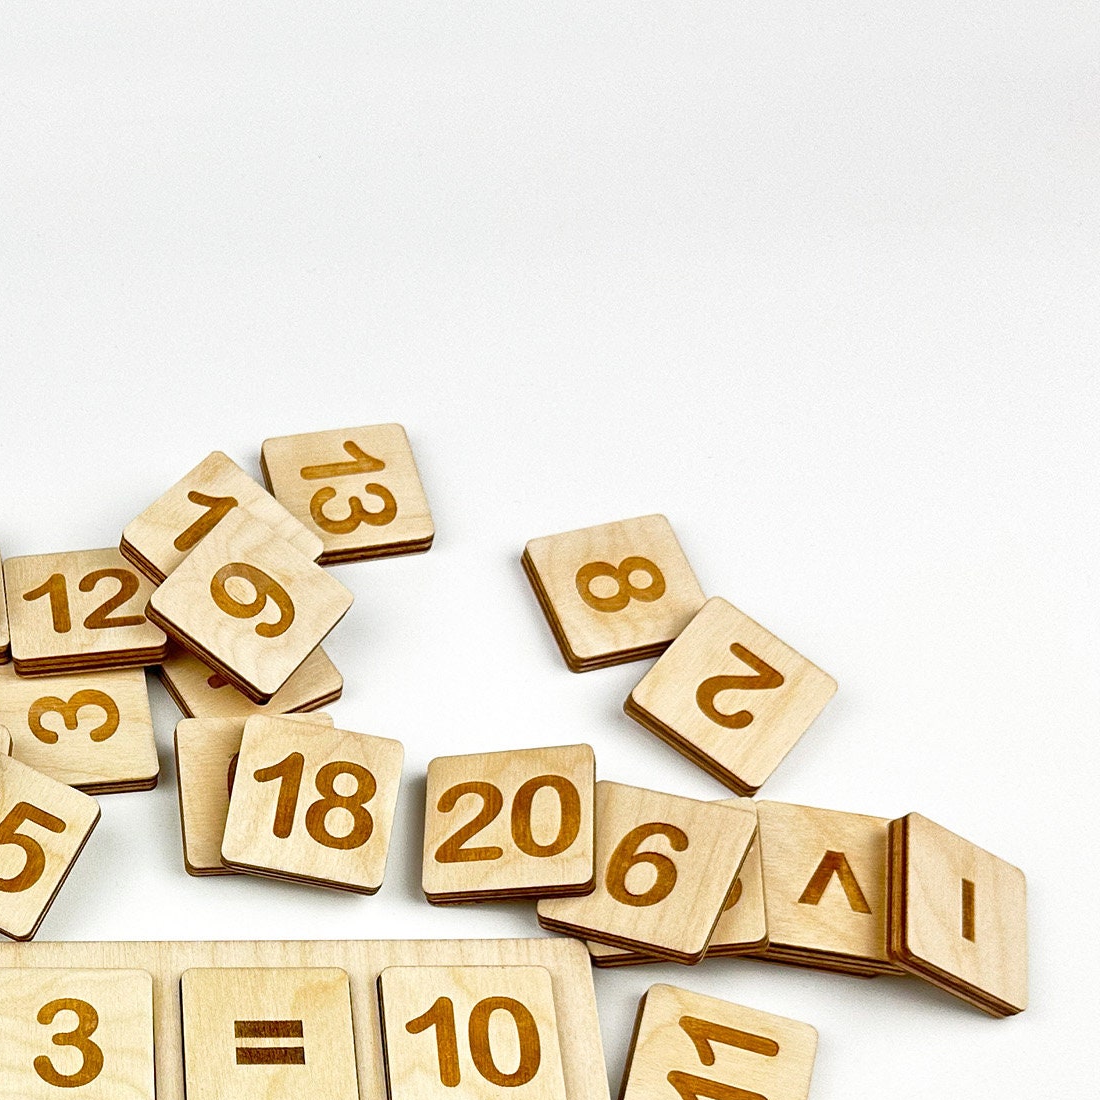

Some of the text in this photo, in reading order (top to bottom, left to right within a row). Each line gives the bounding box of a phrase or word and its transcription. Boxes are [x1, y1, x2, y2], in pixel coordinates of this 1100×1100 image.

[300, 441, 397, 534] 13
[23, 568, 147, 633] 12
[576, 556, 666, 612] 8
[28, 688, 120, 745] 3
[696, 643, 784, 729] 2
[253, 752, 377, 850] 18
[435, 775, 581, 864] 20
[606, 822, 689, 907] 6
[34, 998, 104, 1088] 3
[406, 996, 540, 1088] 10
